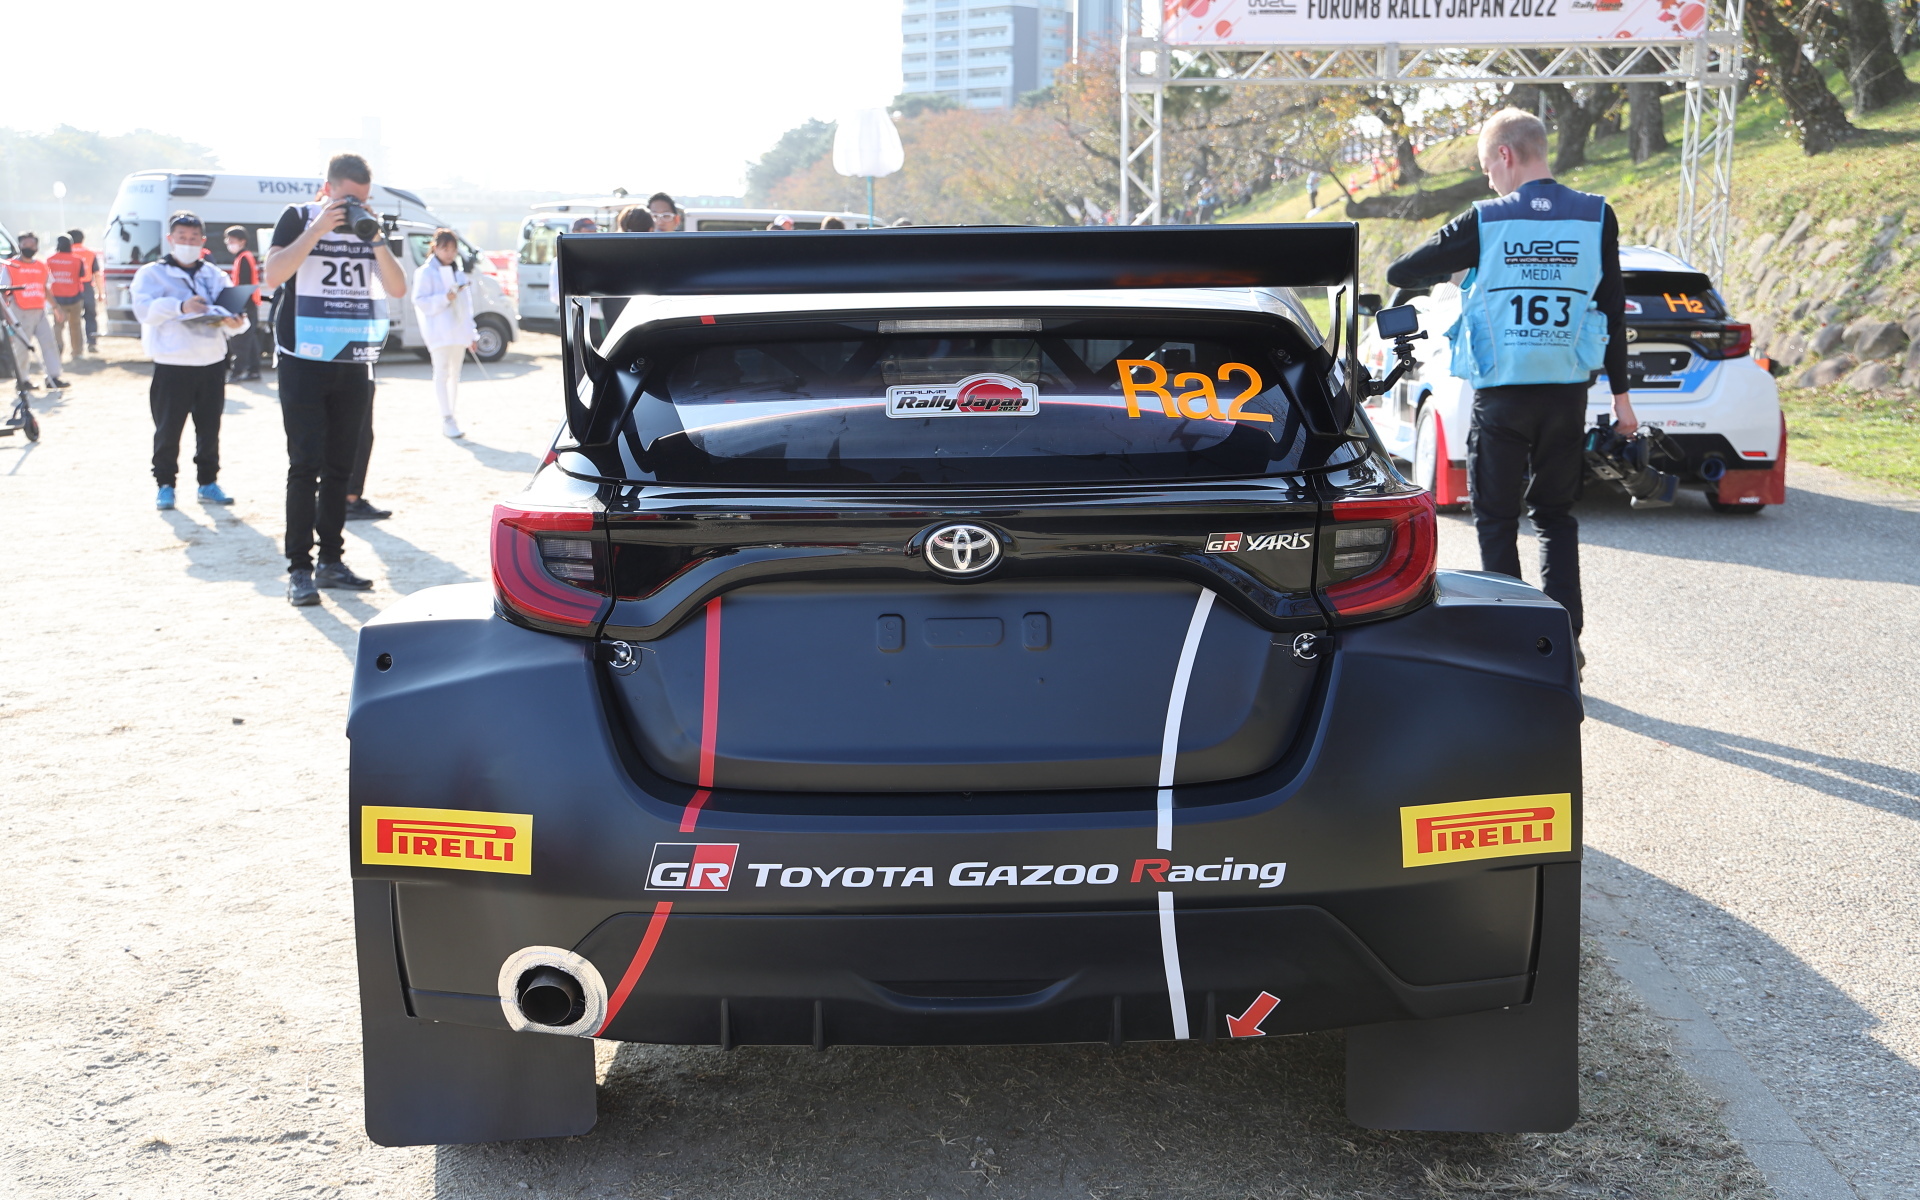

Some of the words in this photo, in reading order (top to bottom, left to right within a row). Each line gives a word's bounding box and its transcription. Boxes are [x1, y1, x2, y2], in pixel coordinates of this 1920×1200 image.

[1307, 0, 1380, 19] FORUM8
[1388, 0, 1442, 18] RALLY
[1446, 0, 1504, 18] JAPAN
[1510, 0, 1557, 17] 2022
[1531, 200, 1550, 210] FIA
[1504, 240, 1580, 255] WRC
[322, 260, 366, 288] 261
[1521, 269, 1562, 280] MEDIA
[1510, 294, 1571, 327] 163
[1662, 292, 1706, 314] H2
[896, 396, 958, 411] Rally
[960, 395, 1029, 411] Japan
[1116, 359, 1274, 423] Ra2
[376, 818, 517, 862] PIRELLI
[1416, 806, 1556, 855] PIRELLI
[650, 862, 730, 887] GR
[748, 863, 934, 888] TOYOTA
[948, 862, 1119, 887] GAZOO
[1130, 857, 1286, 888] Racing
